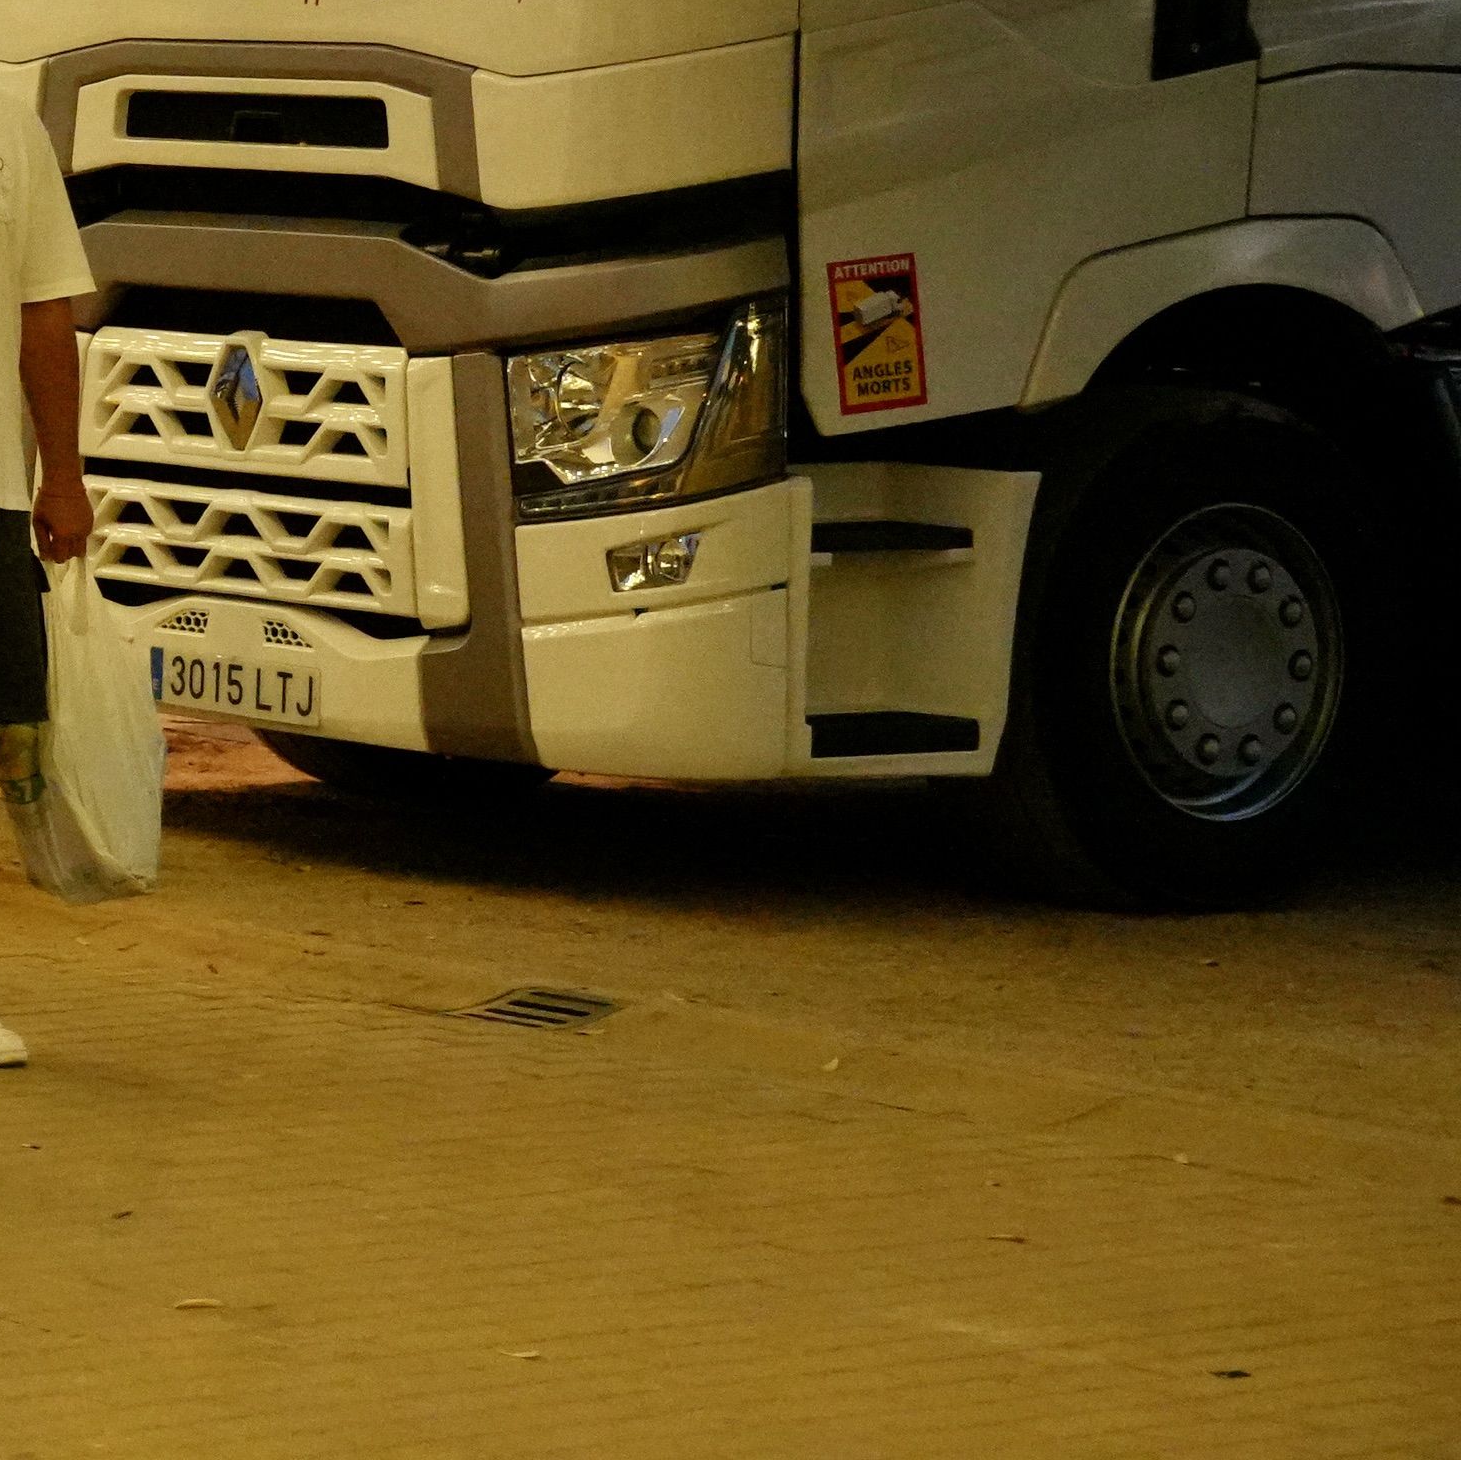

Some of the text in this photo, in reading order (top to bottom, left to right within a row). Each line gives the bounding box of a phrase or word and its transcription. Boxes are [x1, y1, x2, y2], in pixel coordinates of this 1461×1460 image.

[834, 258, 910, 279] ATTENTION
[853, 360, 913, 381] ANGLES
[857, 378, 912, 397] MORTS
[170, 655, 314, 717] 3015 LTJ
